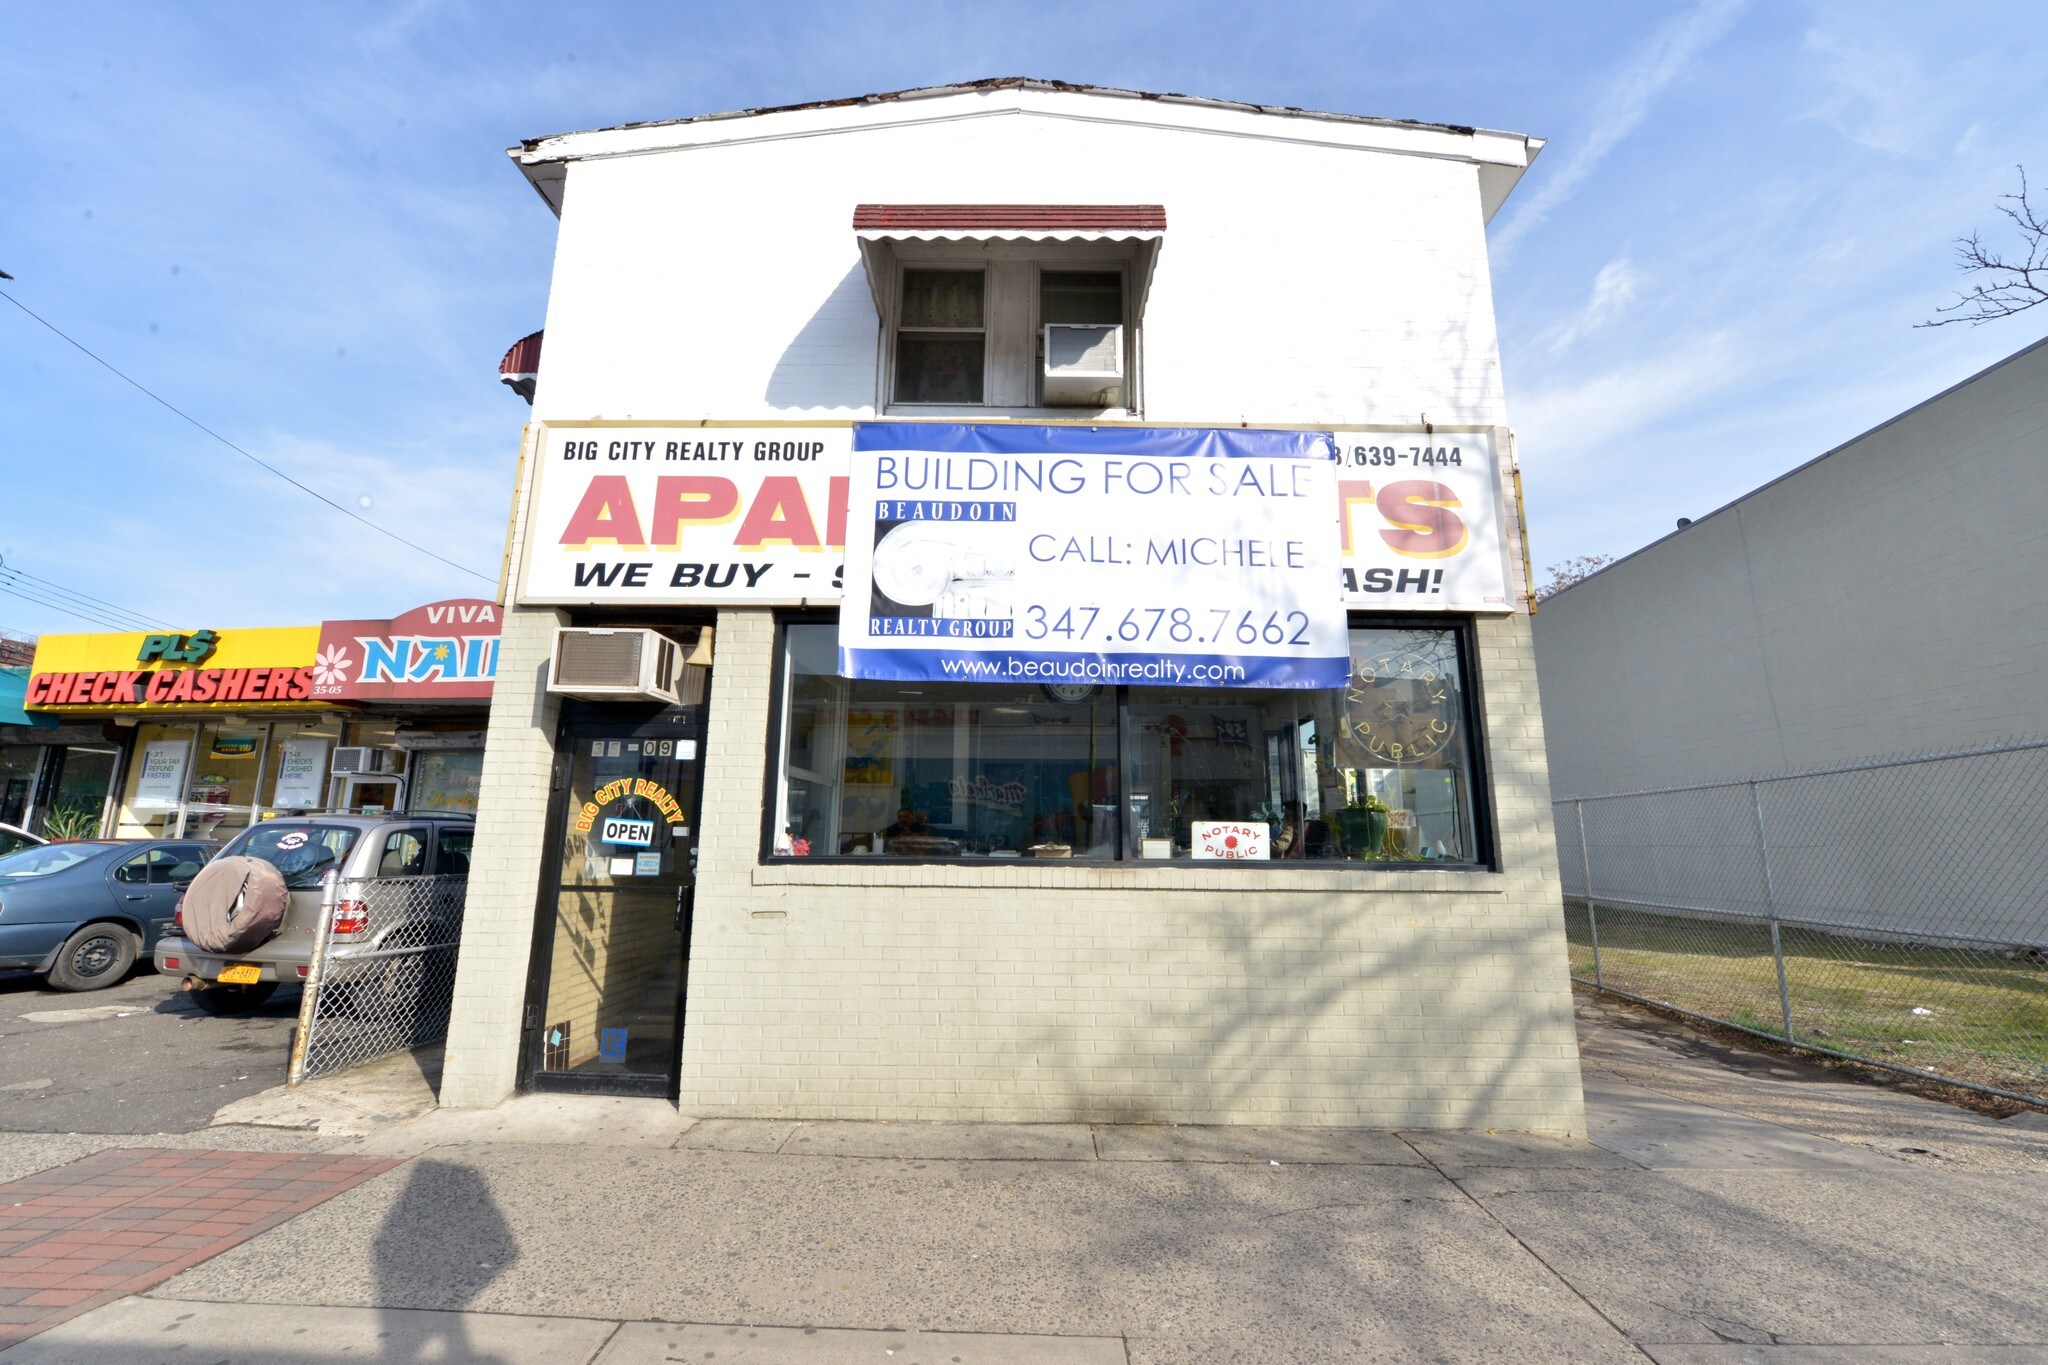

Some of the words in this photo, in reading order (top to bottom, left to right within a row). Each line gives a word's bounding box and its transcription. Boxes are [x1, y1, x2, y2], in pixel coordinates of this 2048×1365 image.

[563, 441, 598, 461] BIG
[608, 441, 656, 461] CITY
[665, 441, 744, 461] REALTY
[754, 441, 825, 462] GROUP
[876, 456, 1086, 495] BUILDING
[1104, 463, 1192, 497] FOR
[1208, 463, 1313, 499] SALE
[878, 502, 1015, 521] BEAUDOIN
[1028, 533, 1132, 565] CALL:
[1145, 537, 1305, 569] MICHELE
[573, 562, 653, 588] WE
[669, 562, 774, 588] BUY
[426, 605, 496, 624] VIVA
[1025, 603, 1311, 646] 347.678.7662
[870, 619, 941, 636] REALTY
[948, 620, 1013, 637] GROUP
[941, 656, 1246, 684] www.beaudoinrealty.com
[1346, 657, 1448, 705] NOTARY
[25, 670, 141, 705] CHECK
[145, 665, 313, 704] CASHERS
[313, 685, 342, 695] 35-05
[1353, 718, 1448, 759] PUBLIC
[576, 801, 600, 832] BIG
[595, 777, 633, 805] CITY
[633, 778, 685, 824] REALTY
[606, 822, 651, 841] OPEN
[1201, 825, 1261, 841] NOTARY
[1205, 845, 1258, 859] PUBLIC
